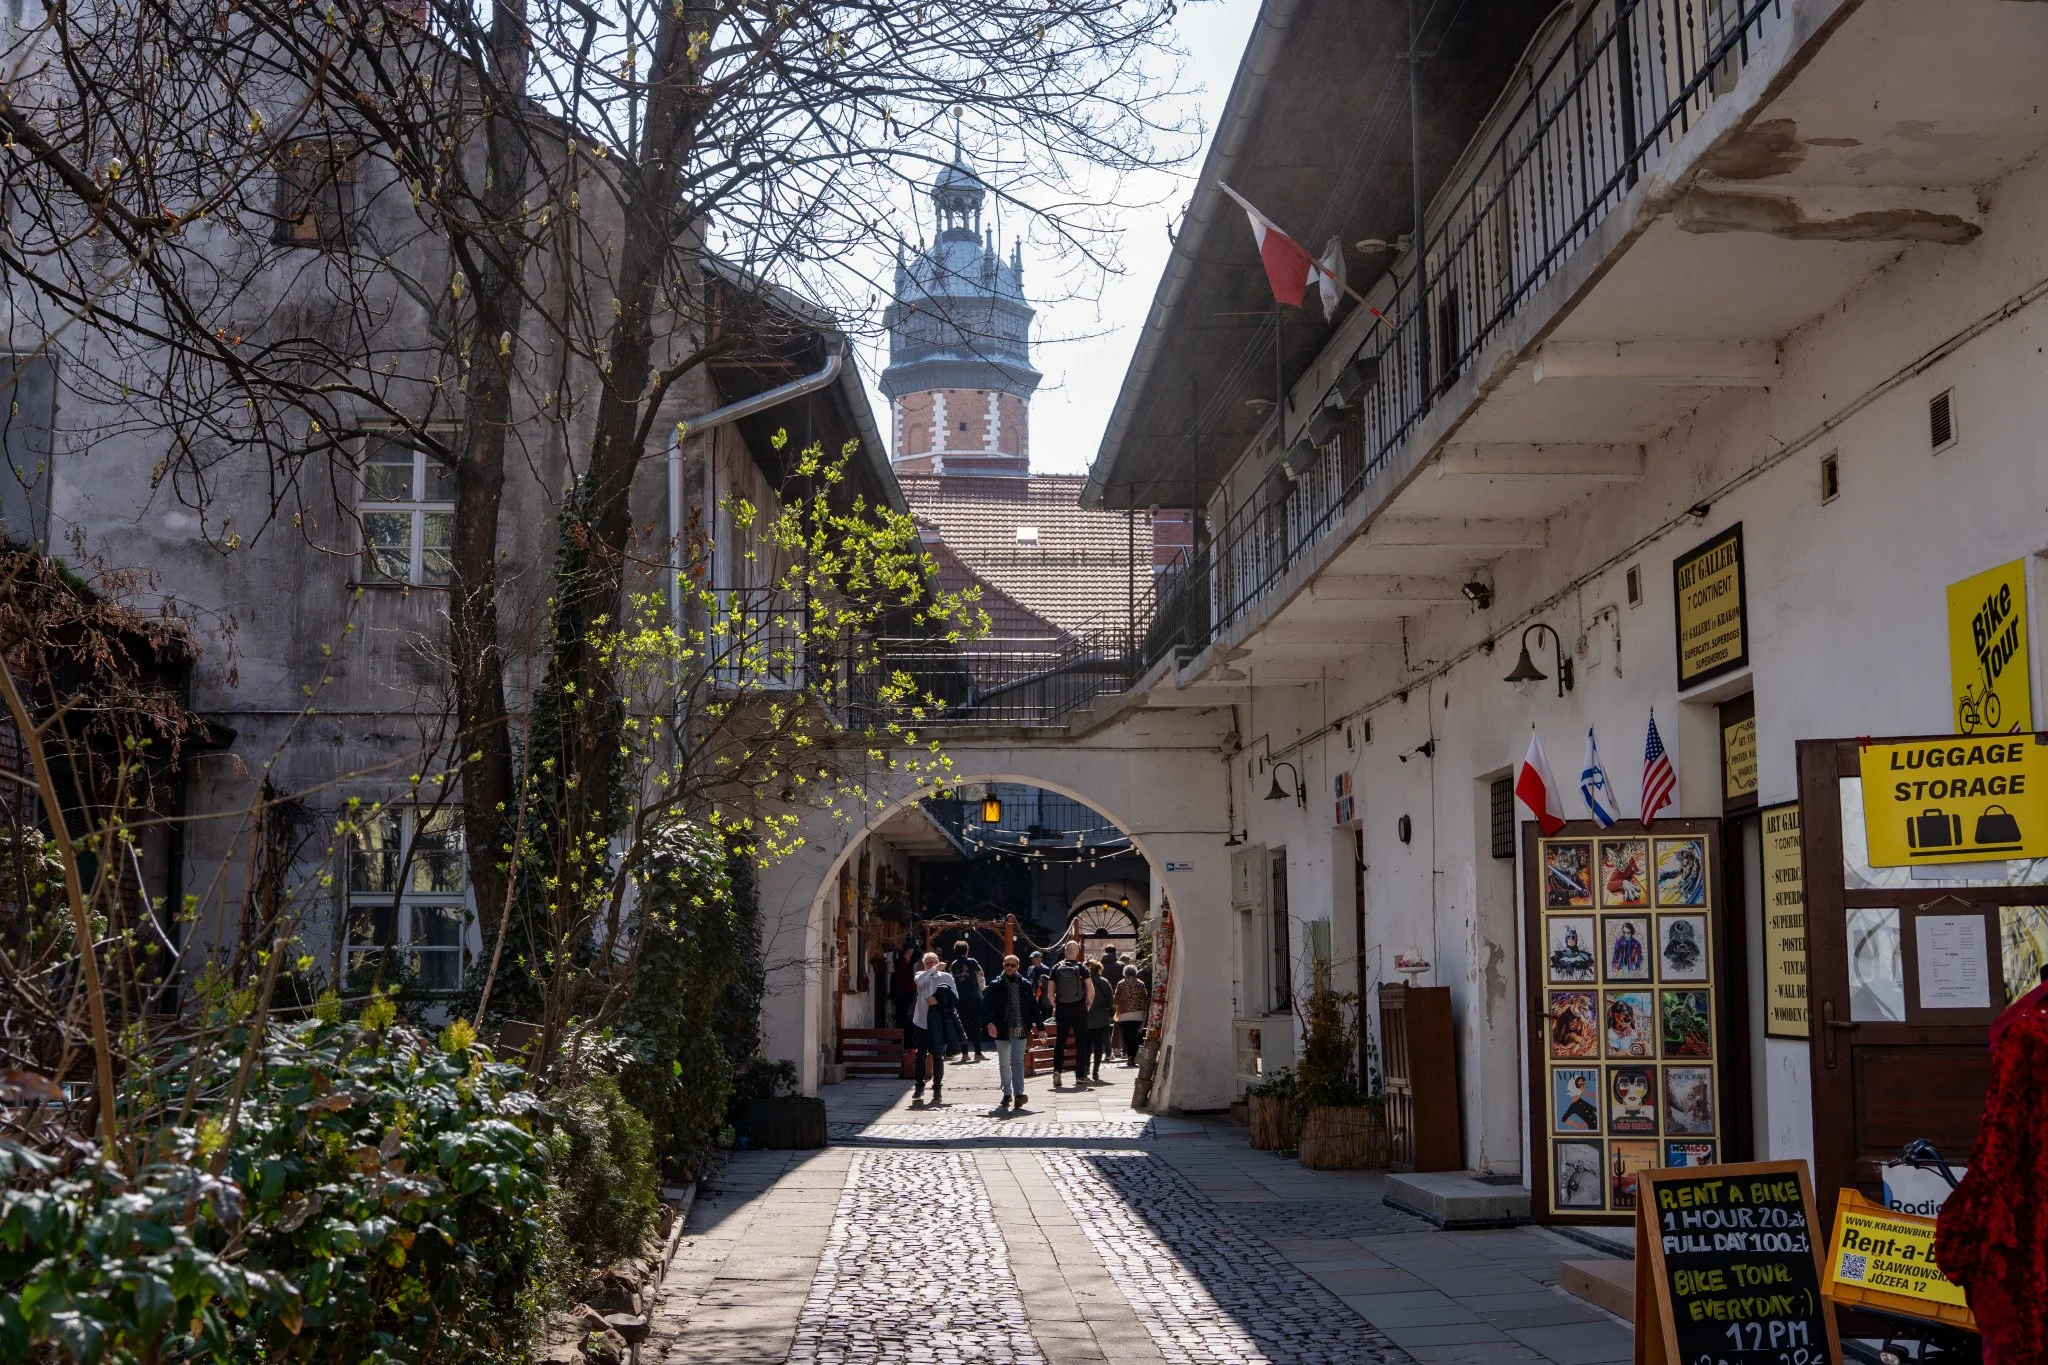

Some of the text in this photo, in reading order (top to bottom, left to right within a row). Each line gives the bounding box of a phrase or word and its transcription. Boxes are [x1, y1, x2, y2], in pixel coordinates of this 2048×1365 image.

[1680, 541, 1739, 591] ART GALLERY
[1687, 575, 1732, 612] 7 CONTINENT
[1689, 618, 1711, 640] GALLERY
[1972, 582, 2011, 657] Bike
[1712, 628, 1740, 649] SUPERDOGS
[1696, 648, 1729, 670] SUPERHEROES
[1981, 613, 2019, 689] Tour
[1890, 743, 2023, 770] LUGGAGE
[1894, 774, 2026, 801] STORAGE
[1766, 815, 1781, 834] ART
[1775, 867, 1802, 883] SUPERC
[1773, 914, 1805, 929] SUPERHE
[1778, 984, 1808, 998] WALL DE
[1774, 1006, 1801, 1022] WOODEN
[1673, 1144, 1708, 1152] MONACO
[1659, 1180, 1800, 1209] RENT A BIKE
[1663, 1211, 1680, 1231] 1
[1682, 1208, 1758, 1229] HOUR
[1662, 1234, 1712, 1255] FULL
[1713, 1231, 1748, 1252] DAY
[1673, 1263, 1793, 1297] BIKE TOUR
[1868, 1272, 1927, 1293] JÓZEFA 12
[1688, 1295, 1795, 1321] EVERYDAY
[1725, 1321, 1764, 1351] 12
